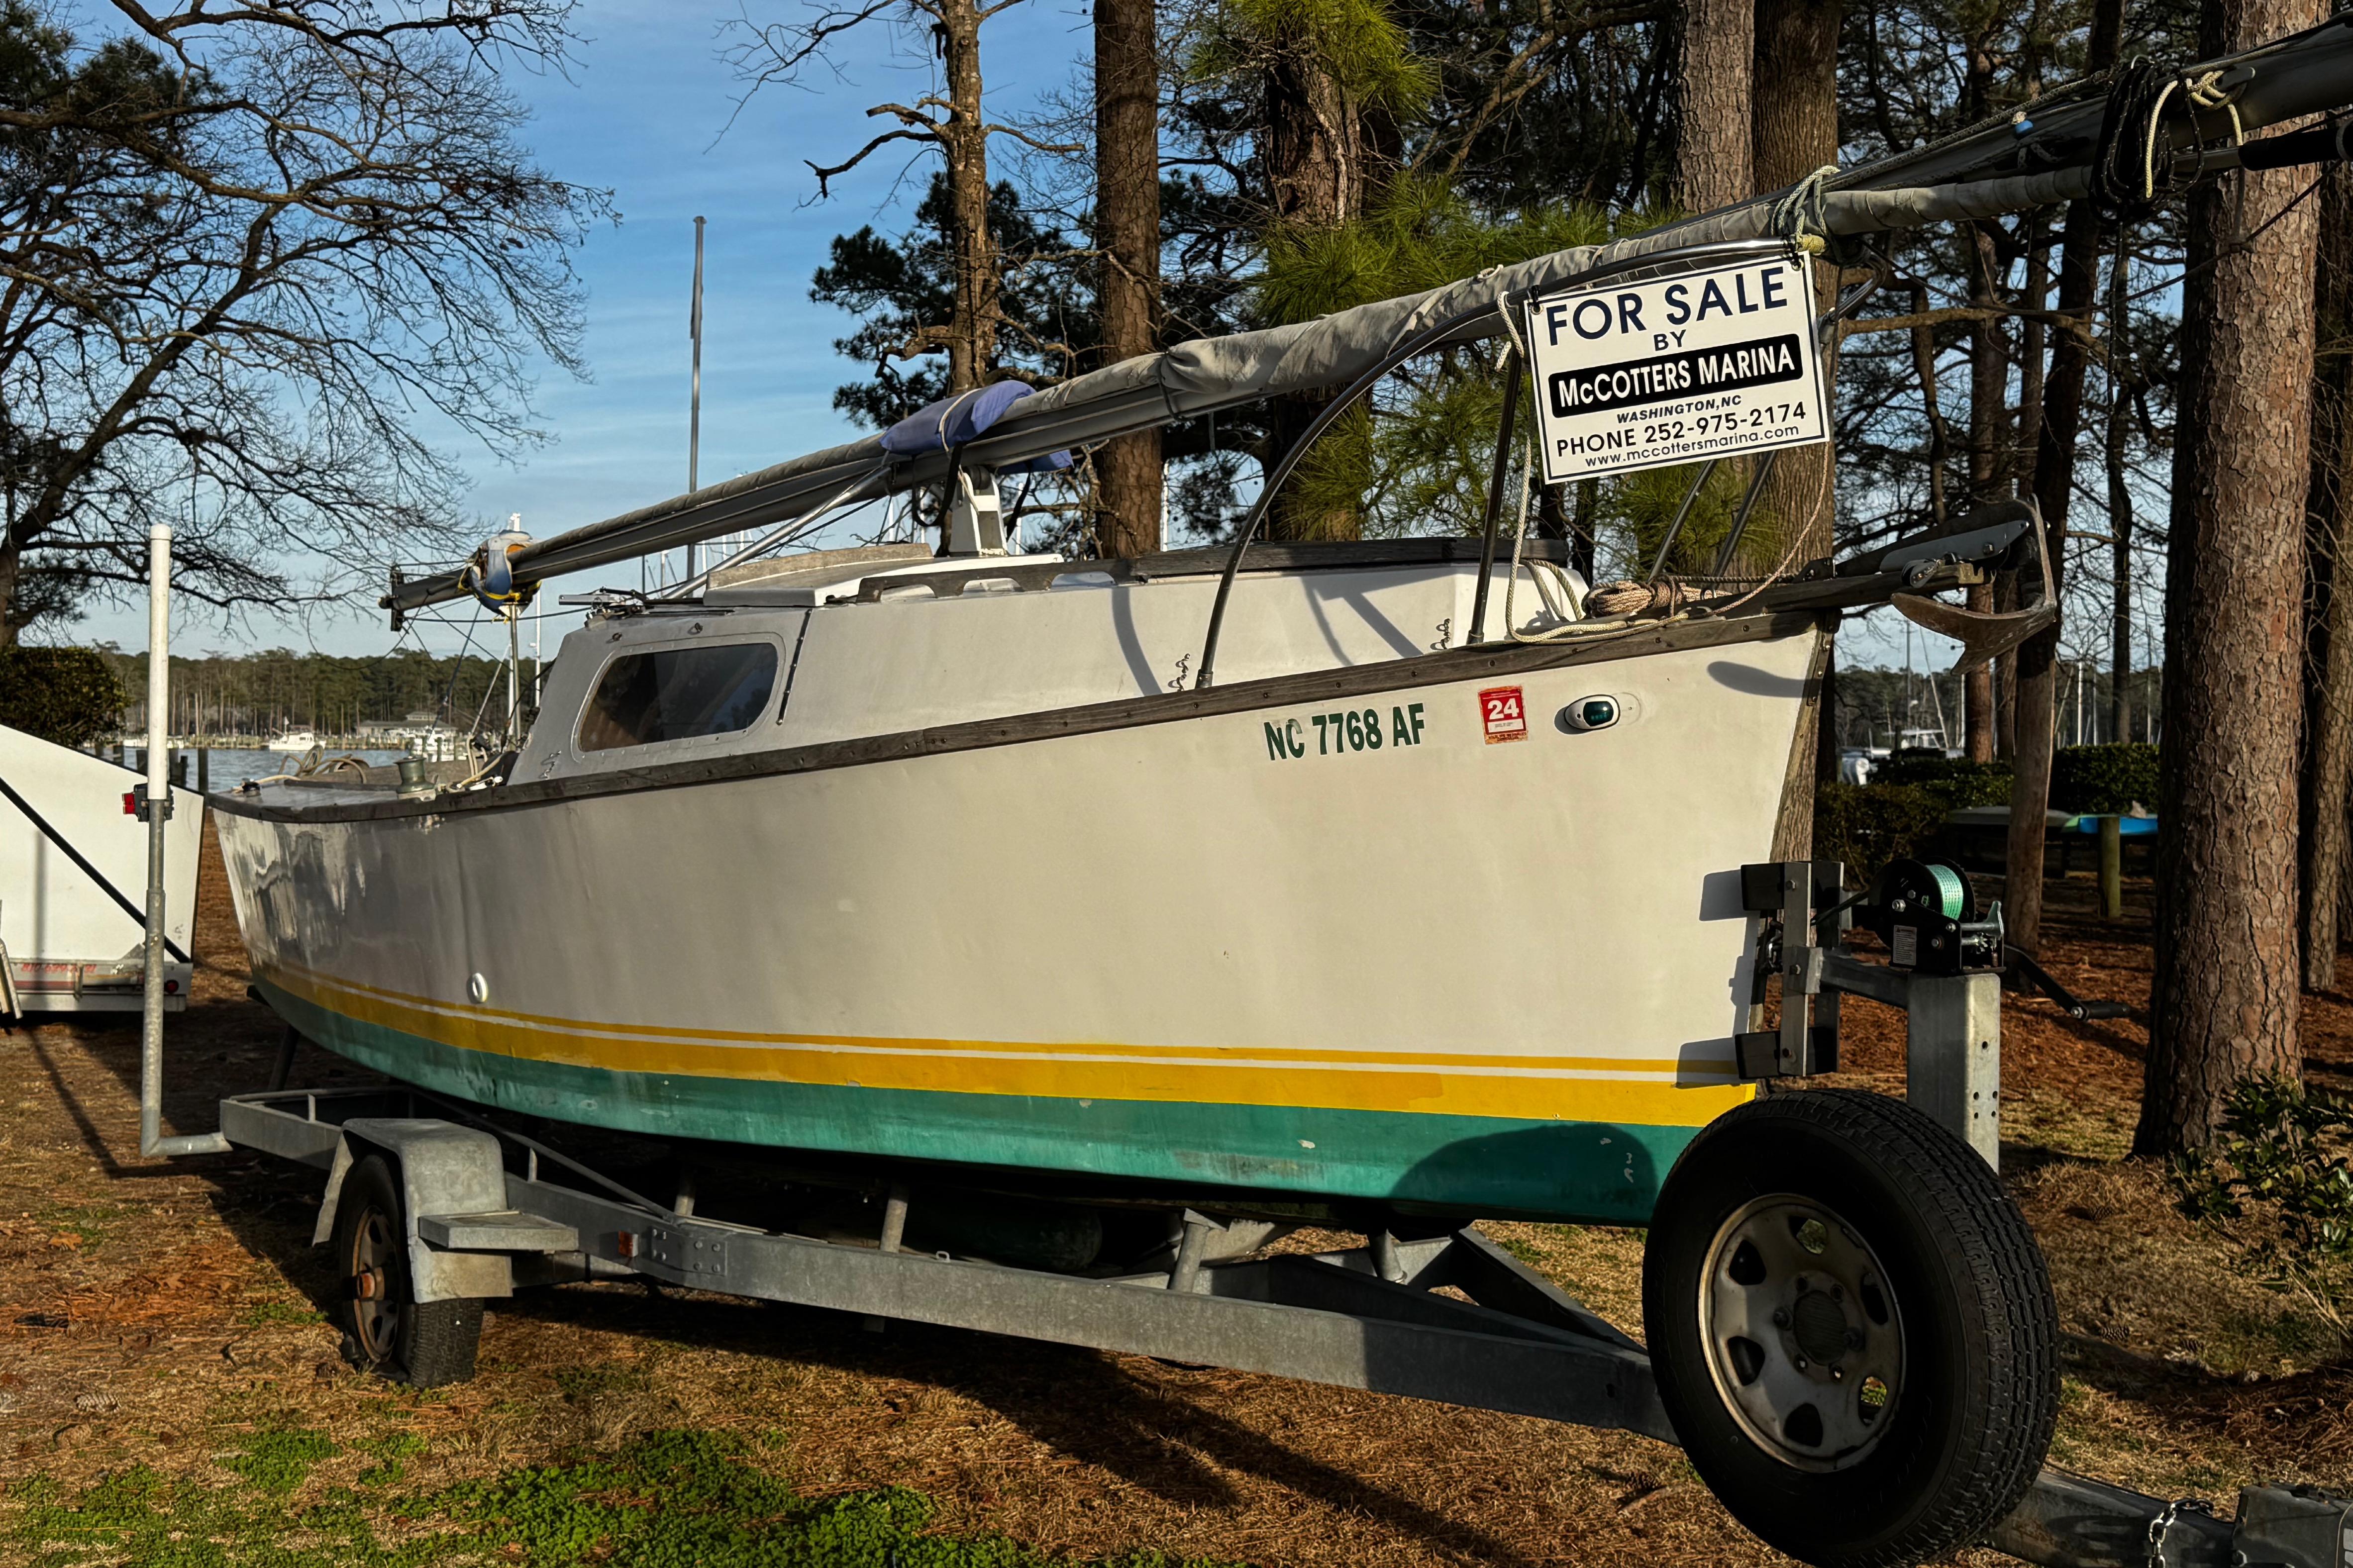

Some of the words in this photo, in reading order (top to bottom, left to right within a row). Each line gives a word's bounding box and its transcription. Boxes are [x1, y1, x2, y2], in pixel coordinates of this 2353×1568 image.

[1546, 293, 1647, 346] FOR
[1664, 266, 1787, 325] SALE
[1653, 329, 1686, 351] BY
[1558, 360, 1691, 407] McCOTTERS
[1698, 343, 1795, 385] MARINA
[1557, 428, 1637, 457] PHONE
[1644, 401, 1806, 443] 252-975-2174
[1585, 426, 1799, 467] www.mccottersmarina.com
[1264, 718, 1305, 761] NC
[1311, 708, 1383, 755] 7768
[1393, 702, 1425, 747] AF
[1487, 697, 1520, 720] 24
